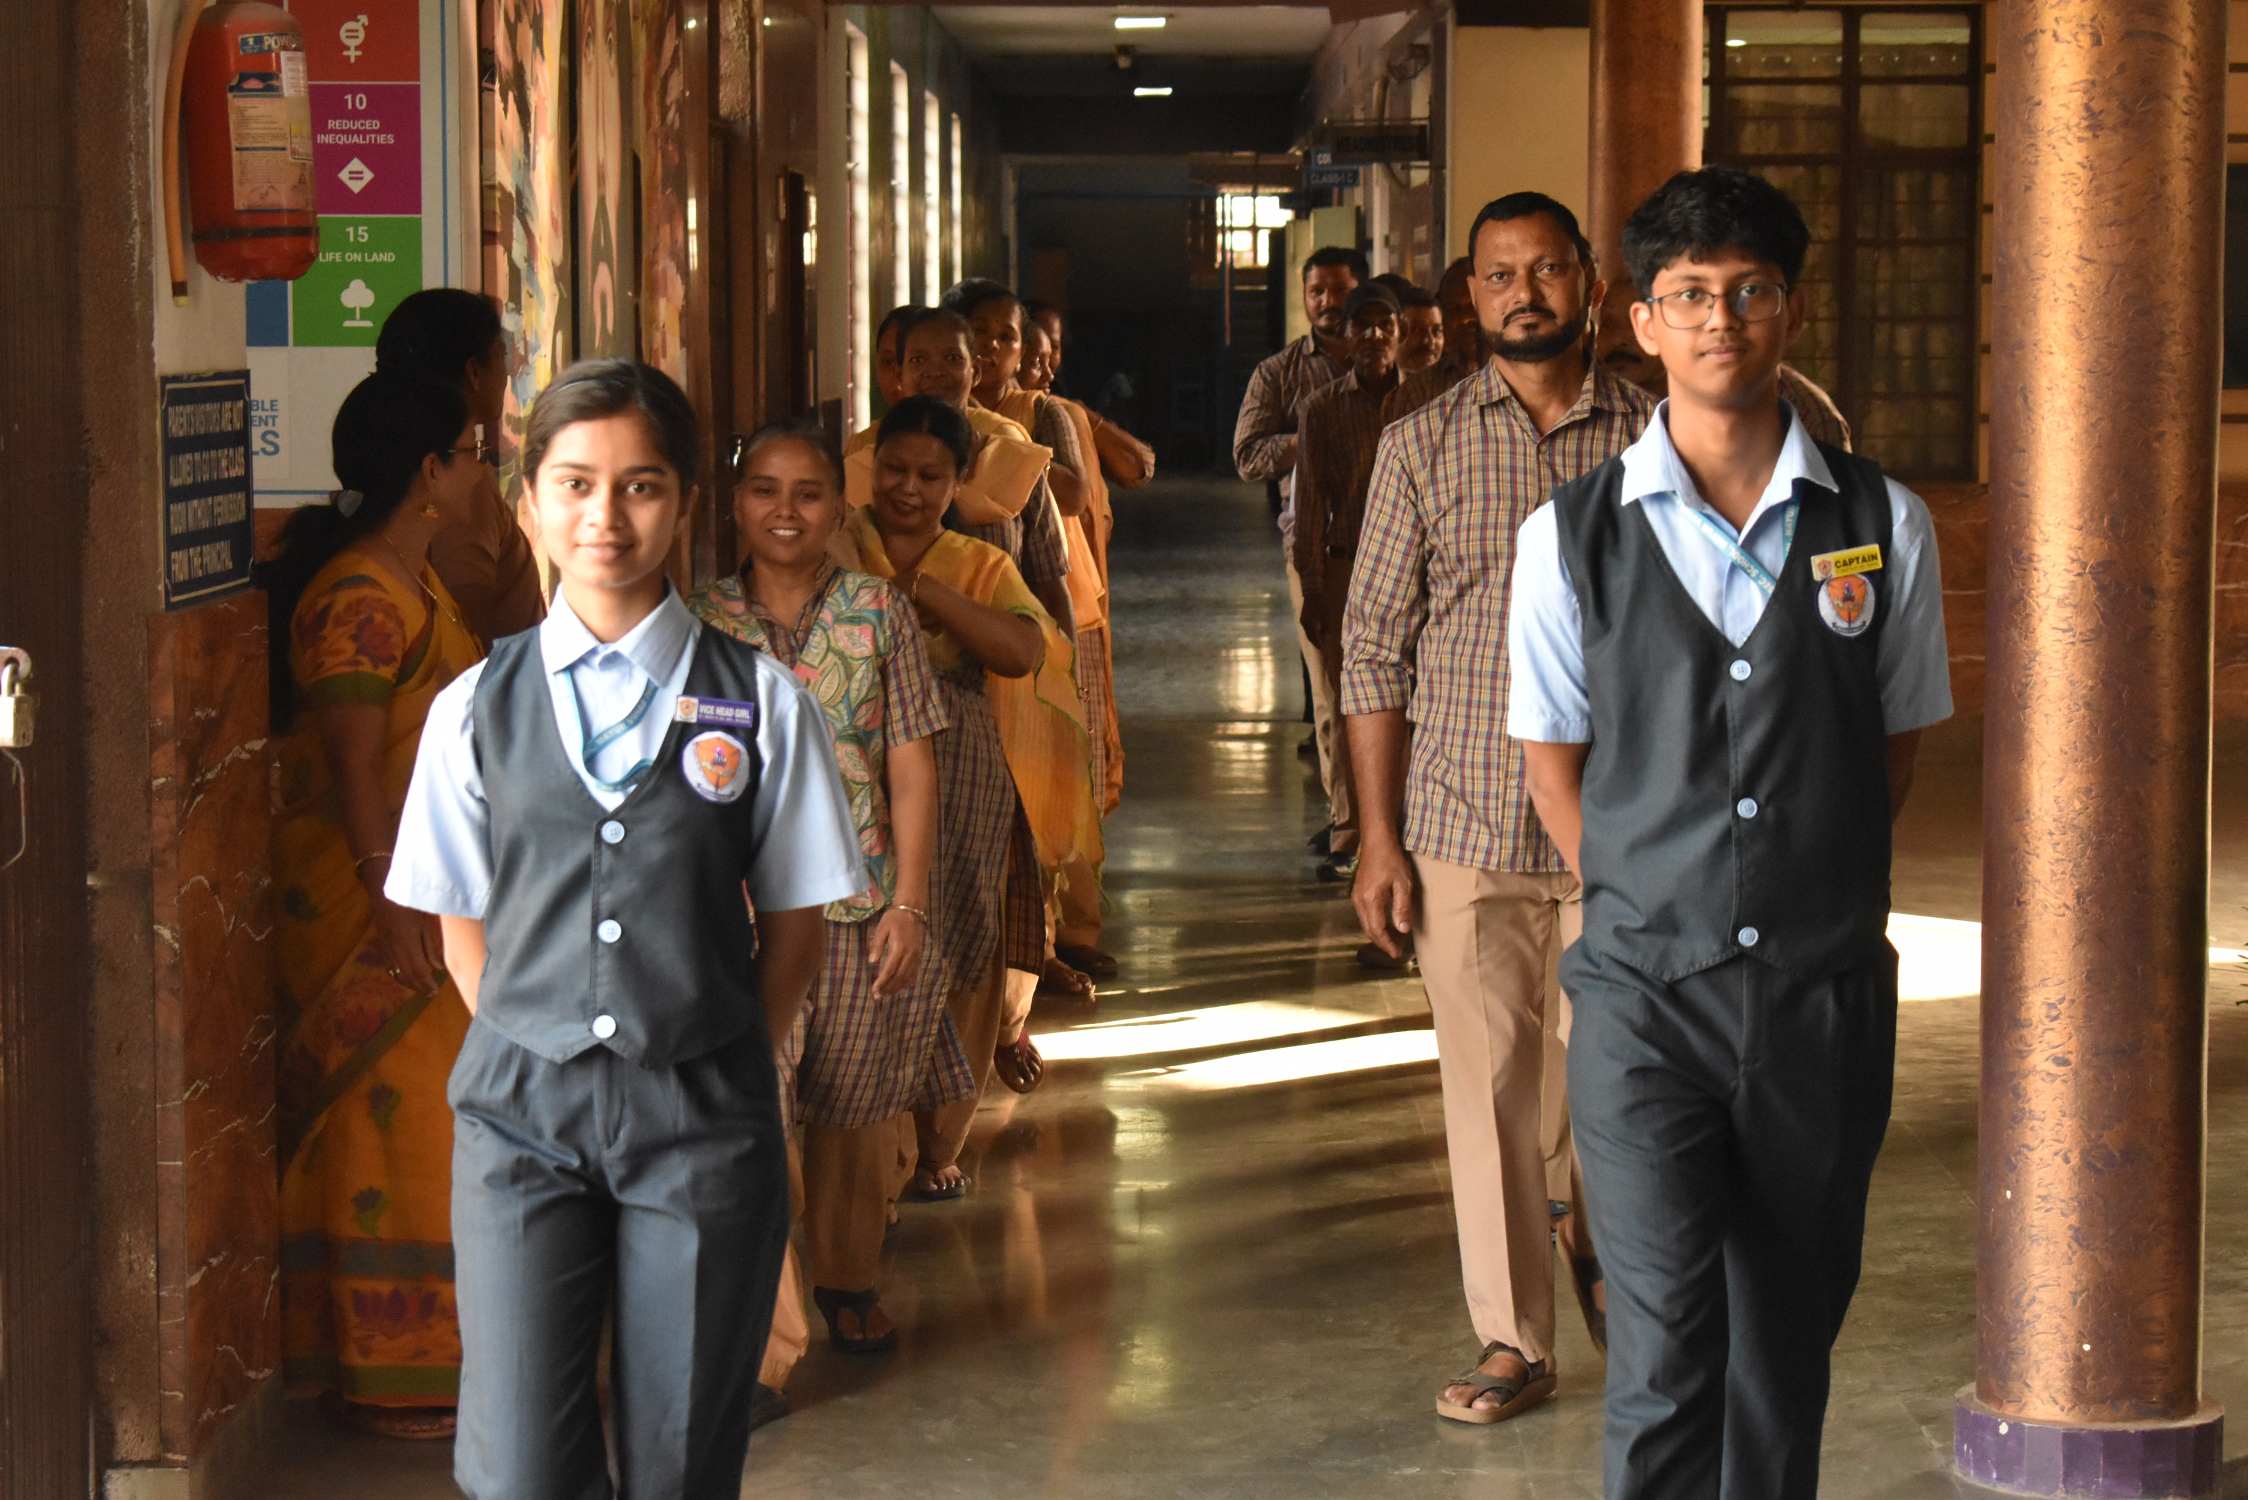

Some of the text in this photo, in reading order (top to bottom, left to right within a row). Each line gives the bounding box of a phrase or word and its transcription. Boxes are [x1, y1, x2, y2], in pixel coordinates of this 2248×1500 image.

[343, 93, 368, 111] 10
[327, 119, 381, 131] REDUCED
[316, 133, 396, 145] INEQUALITIES
[345, 226, 369, 243] 15
[319, 252, 396, 263] LIFE ON LAND
[1834, 552, 1878, 568] CAPTAIN
